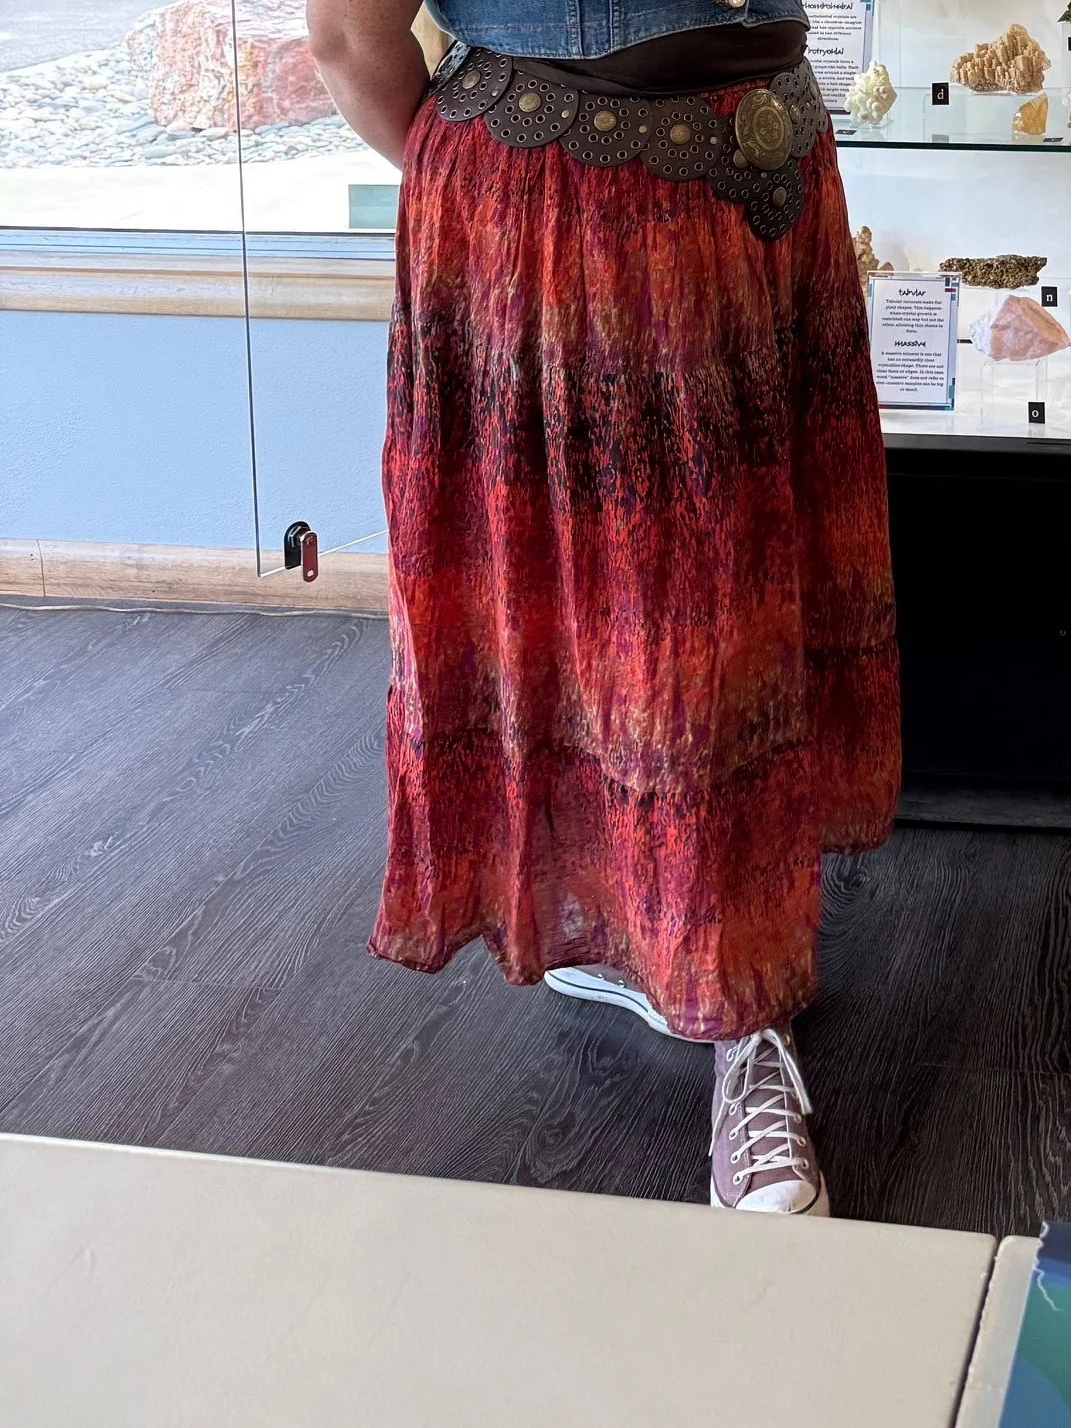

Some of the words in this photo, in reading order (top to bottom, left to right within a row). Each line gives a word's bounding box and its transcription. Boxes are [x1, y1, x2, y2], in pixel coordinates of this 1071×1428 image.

[937, 90, 944, 99] d
[899, 288, 926, 297] tabular
[1046, 293, 1053, 302] n
[1032, 410, 1039, 418] o
